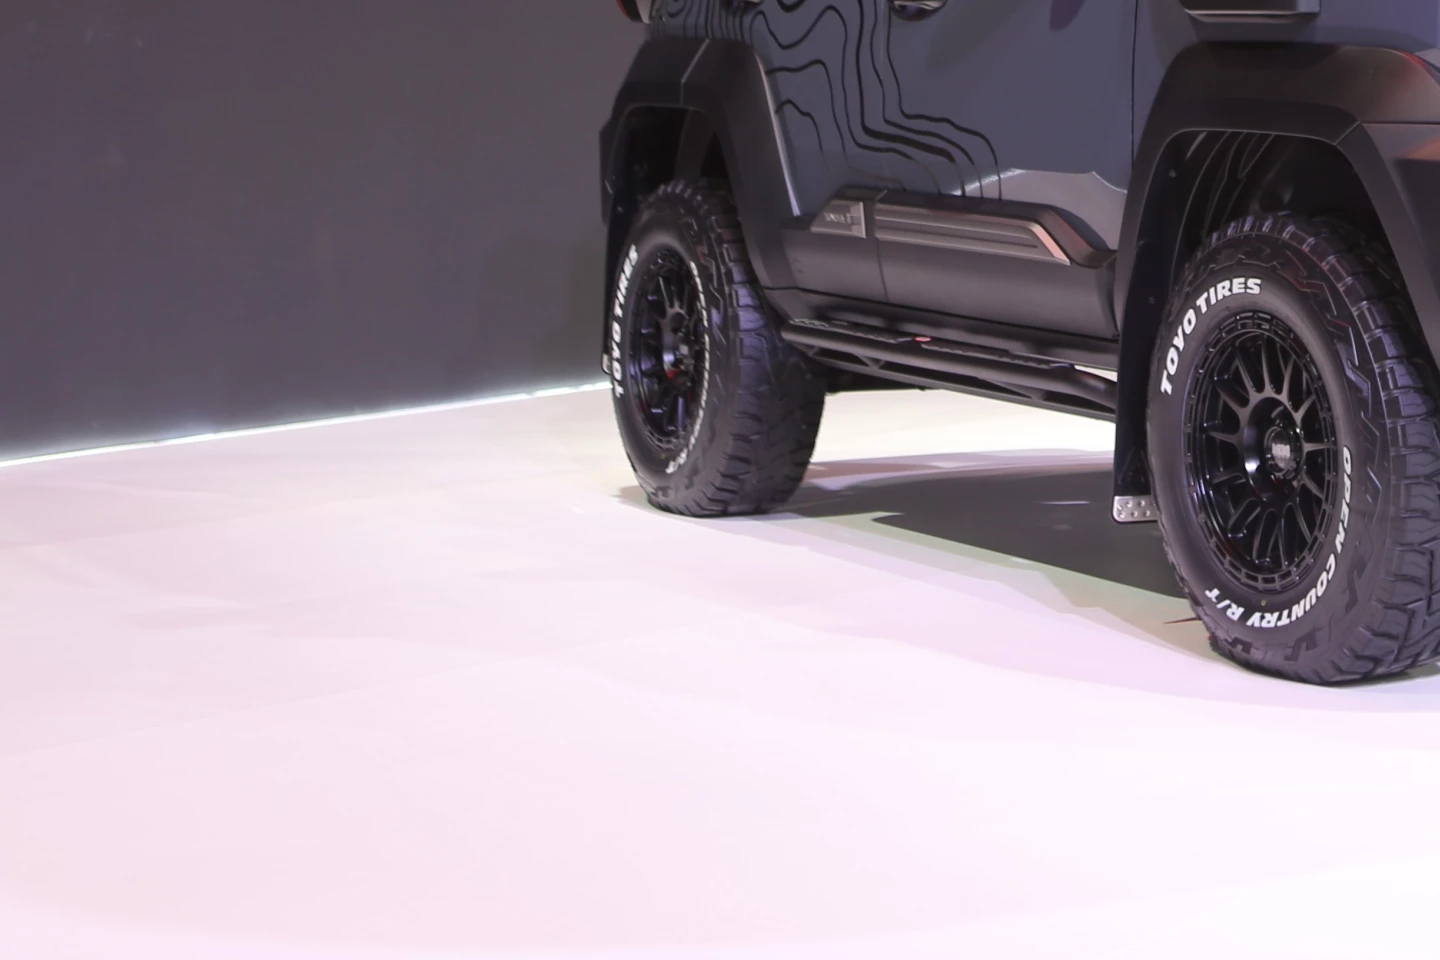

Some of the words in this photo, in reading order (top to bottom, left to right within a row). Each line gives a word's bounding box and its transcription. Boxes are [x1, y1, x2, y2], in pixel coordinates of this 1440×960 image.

[1160, 307, 1197, 396] TOYO
[1195, 276, 1262, 315] TIRES
[1334, 445, 1352, 555] OPEN
[1204, 587, 1245, 622] R/T
[1245, 552, 1336, 629] COUNTRY
